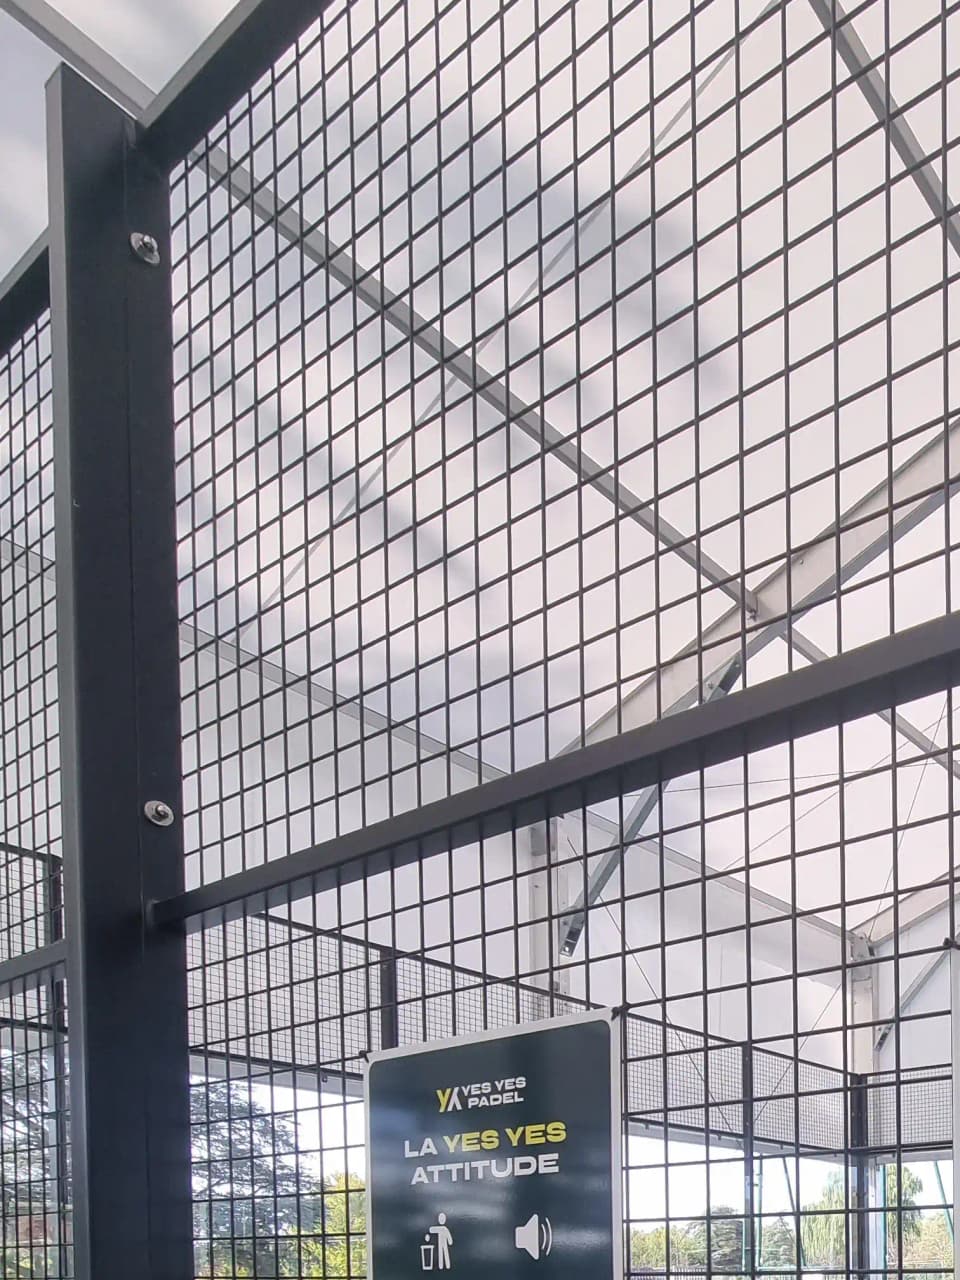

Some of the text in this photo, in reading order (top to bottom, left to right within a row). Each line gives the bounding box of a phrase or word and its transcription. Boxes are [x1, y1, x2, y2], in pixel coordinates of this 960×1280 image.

[462, 1082, 492, 1096] YES
[494, 1076, 526, 1091] YES
[468, 1091, 524, 1109] PADEL
[404, 1121, 567, 1158] LA YES YES
[410, 1153, 559, 1185] ATTITUDE
